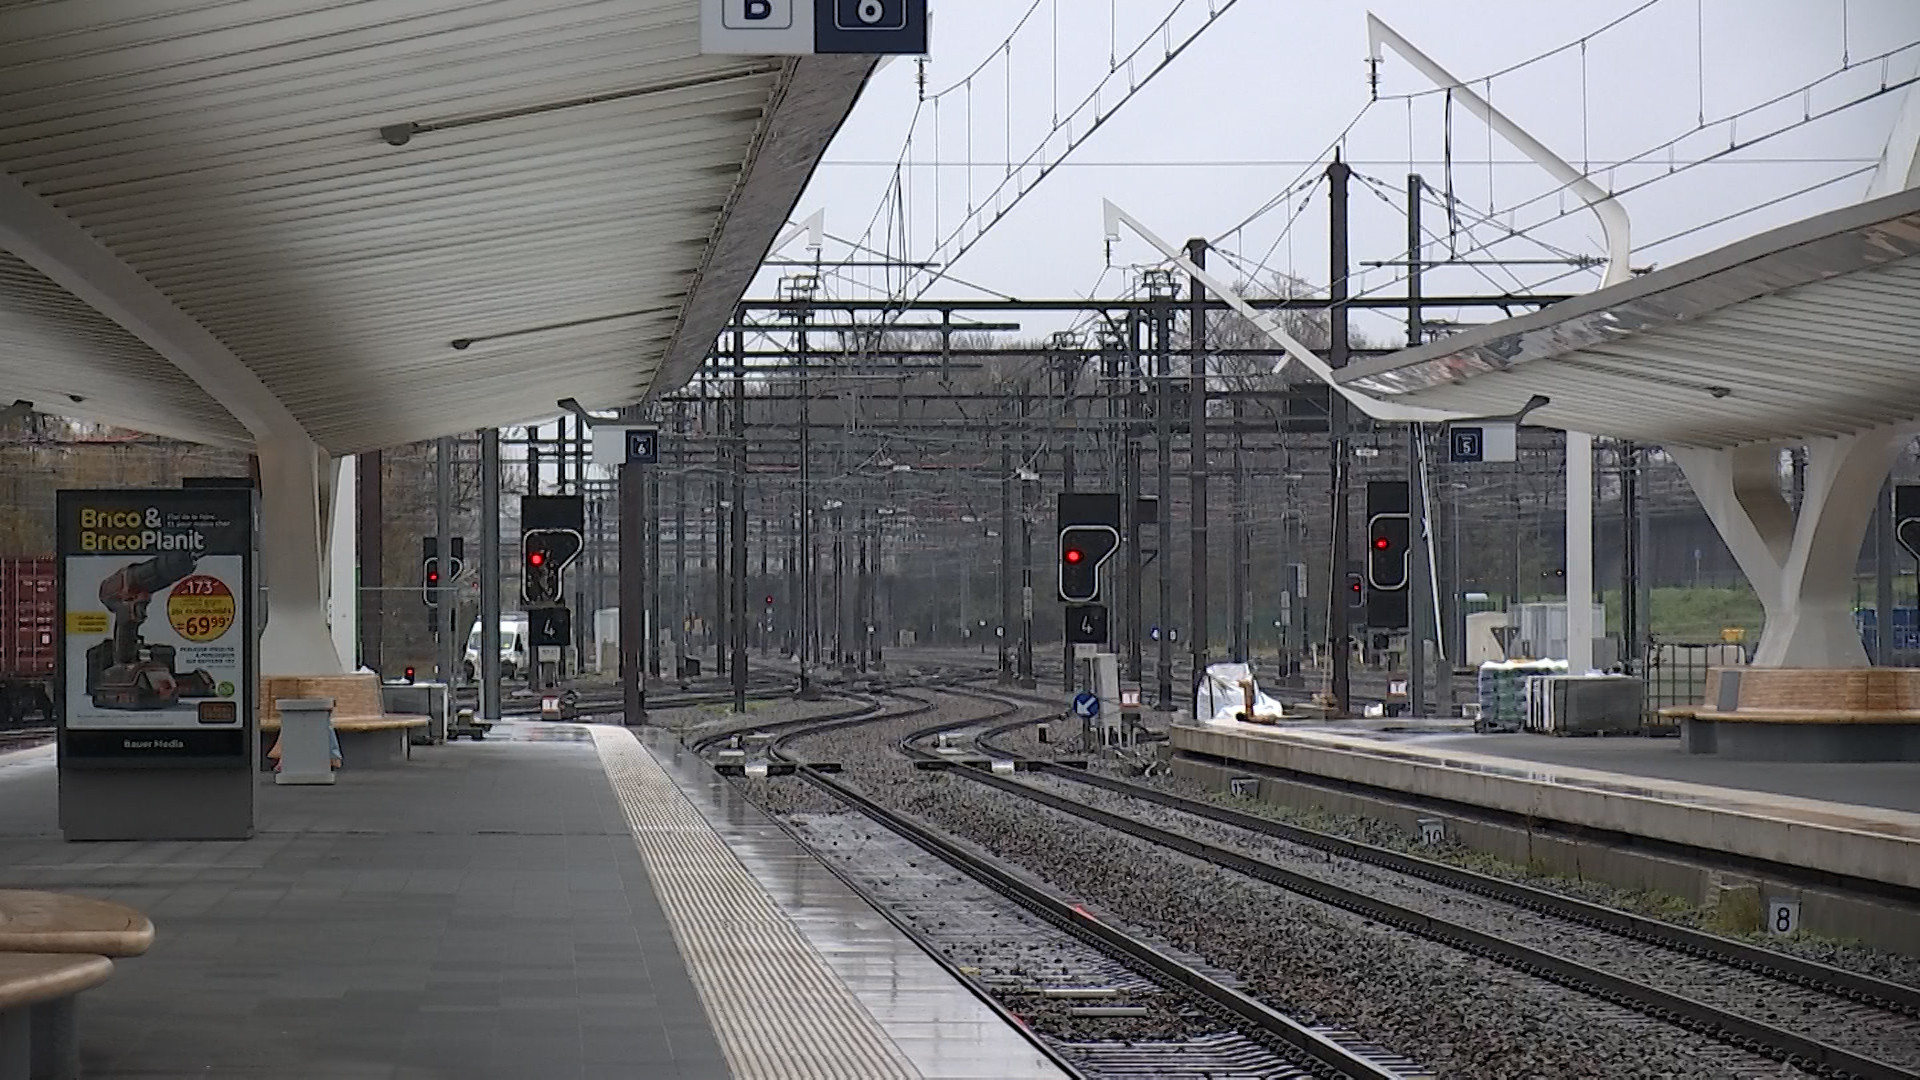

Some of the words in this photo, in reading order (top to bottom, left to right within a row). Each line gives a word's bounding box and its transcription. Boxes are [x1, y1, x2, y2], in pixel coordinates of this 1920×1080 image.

[638, 443, 646, 454] 6
[1463, 441, 1471, 453] 5
[81, 508, 142, 528] Brico
[145, 507, 162, 528] &
[81, 530, 205, 550] BricoPlanit
[543, 619, 556, 637] 4
[1081, 615, 1093, 634] 4
[154, 739, 184, 748] Media
[1776, 907, 1790, 932] 8
